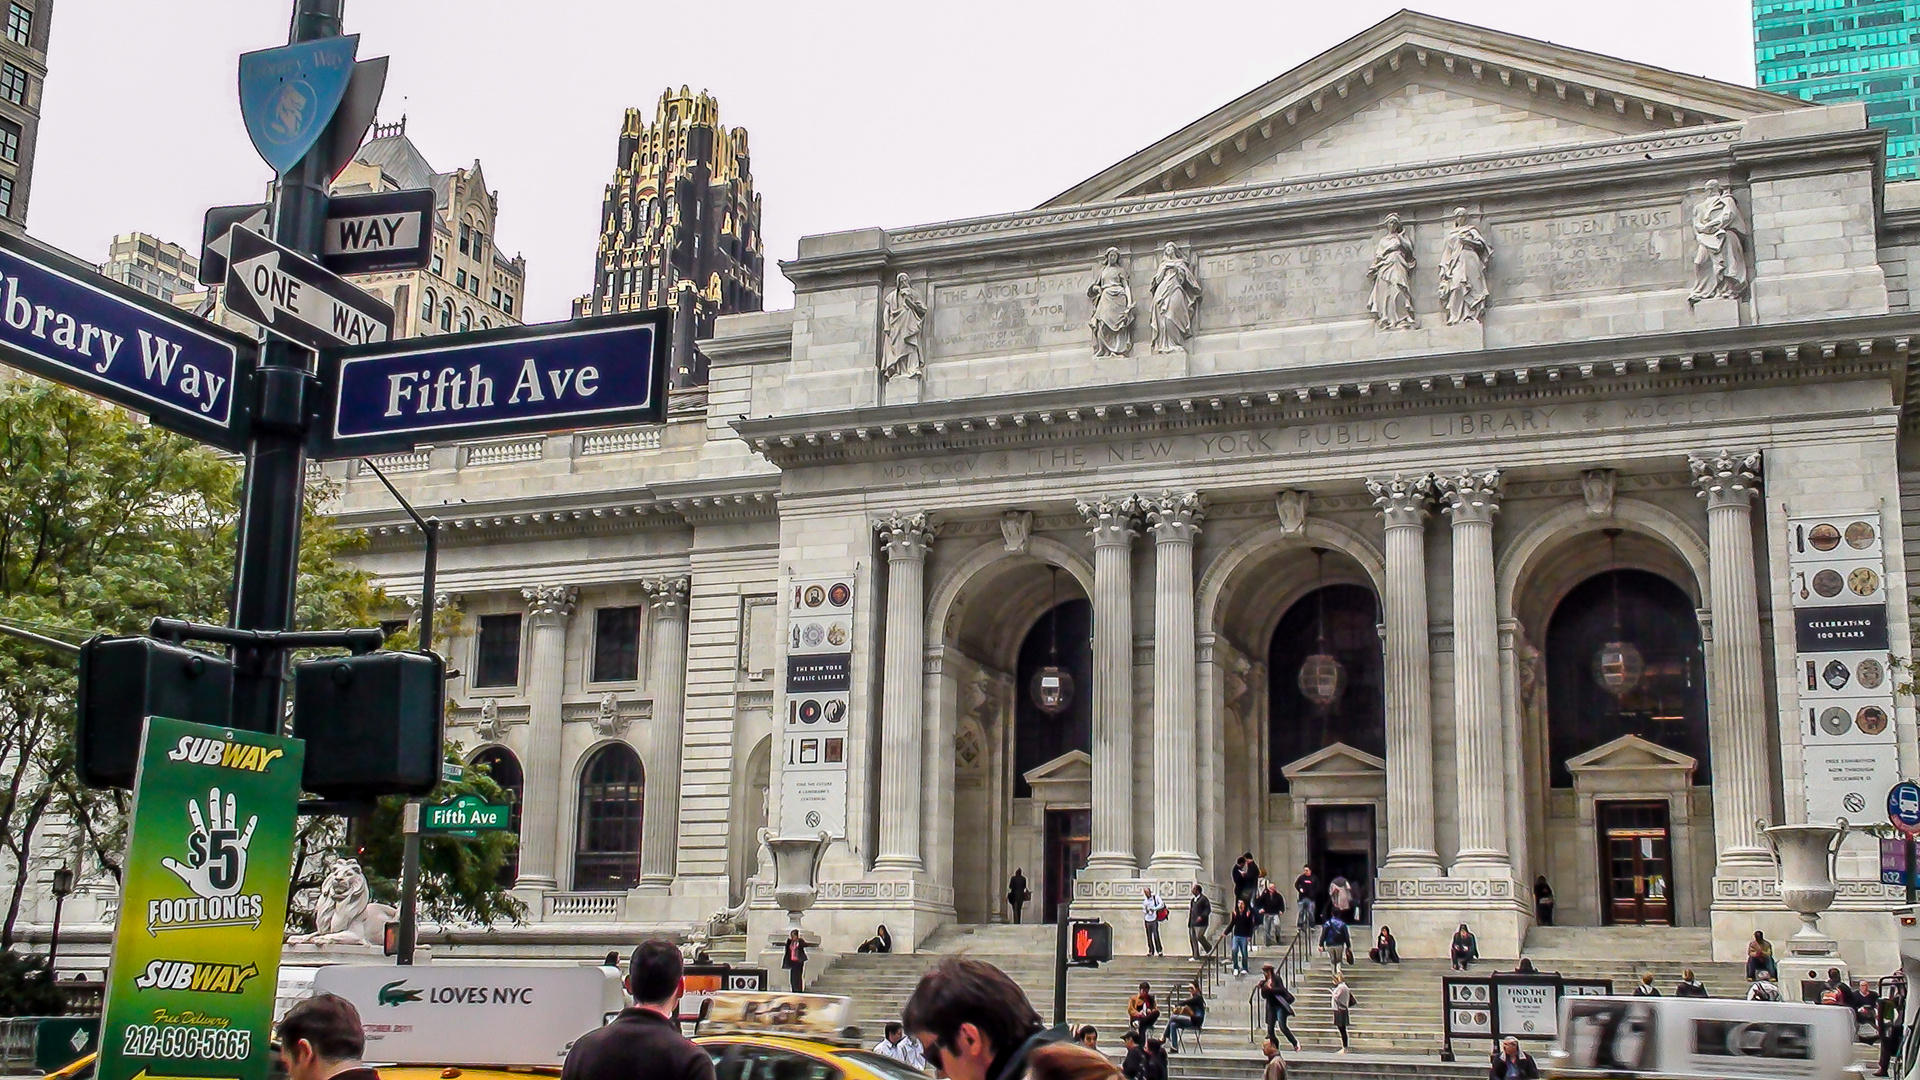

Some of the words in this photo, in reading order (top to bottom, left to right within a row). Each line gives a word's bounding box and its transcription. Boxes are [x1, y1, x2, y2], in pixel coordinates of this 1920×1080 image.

[340, 217, 404, 250] WAY
[1500, 226, 1531, 243] THE
[1545, 218, 1604, 238] TILDEN
[1619, 210, 1671, 229] TRUST
[1207, 259, 1236, 275] THE
[1300, 245, 1363, 264] LIBRARY
[943, 289, 969, 304] THE
[976, 282, 1019, 300] ASTOR
[1025, 276, 1084, 295] LIBRARY
[1241, 281, 1279, 294] JAMES
[254, 264, 301, 314] ONE
[332, 302, 376, 344] WAY
[1031, 304, 1064, 317] ASTOR
[138, 328, 226, 413] Way
[384, 364, 494, 417] Fifth
[509, 358, 599, 404] Ave
[1031, 448, 1087, 468] THE
[1107, 440, 1174, 463] NEW
[1200, 430, 1273, 455] YORK
[1298, 420, 1400, 448] PUBLIC
[1430, 408, 1557, 437] LIBRARY
[1808, 619, 1871, 628] CELEBRATING
[168, 736, 284, 772] SUBWAY
[433, 809, 466, 825] Fifth
[470, 810, 497, 825] Ave
[187, 828, 240, 891] $5
[149, 894, 263, 924] FOOTLONGS
[136, 959, 259, 993] SUBWAY
[430, 987, 488, 1005] LOVES
[492, 988, 533, 1005] NYC
[1507, 988, 1529, 996] FIND
[1529, 988, 1547, 996] THE
[1512, 996, 1543, 1004] FUTURE
[153, 1008, 178, 1025] Free
[181, 1011, 231, 1029] Delivery
[123, 1024, 251, 1060] 212-696-5665
